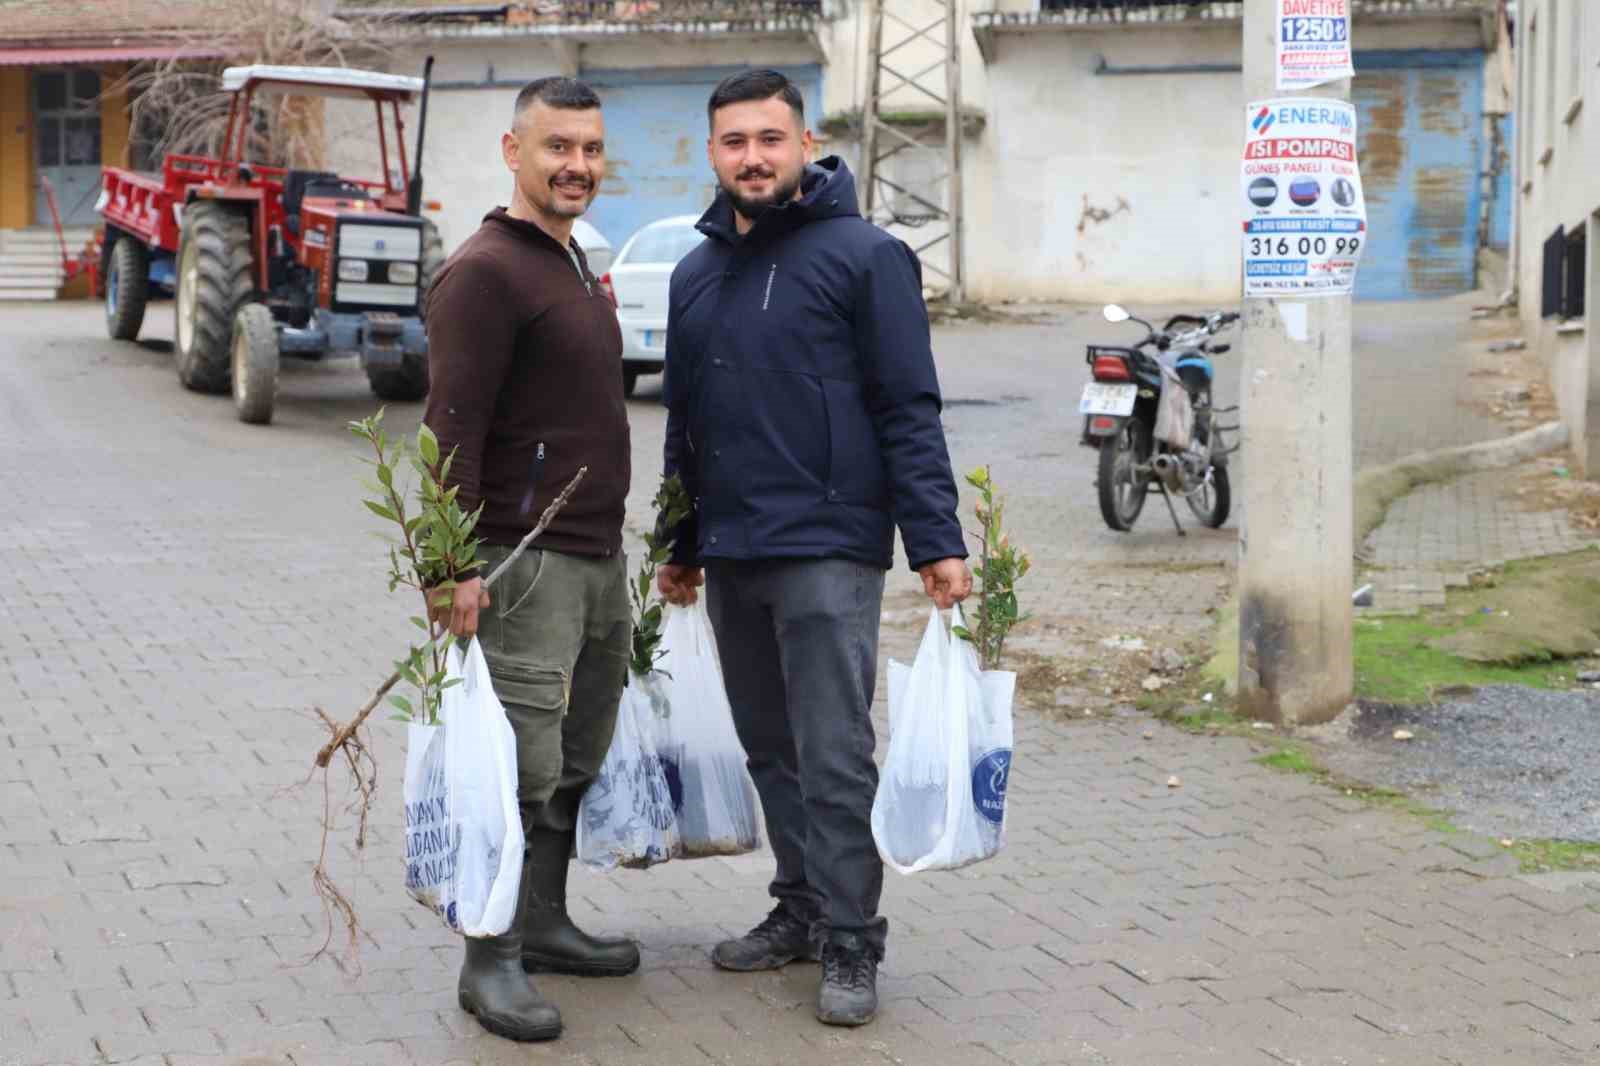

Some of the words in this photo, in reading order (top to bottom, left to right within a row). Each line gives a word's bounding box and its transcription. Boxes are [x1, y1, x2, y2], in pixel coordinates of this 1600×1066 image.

[1251, 141, 1272, 158] ISI
[1277, 139, 1350, 160] POMPASI
[1251, 237, 1289, 255] 316
[1298, 237, 1326, 255] 00
[1336, 237, 1359, 254] 99
